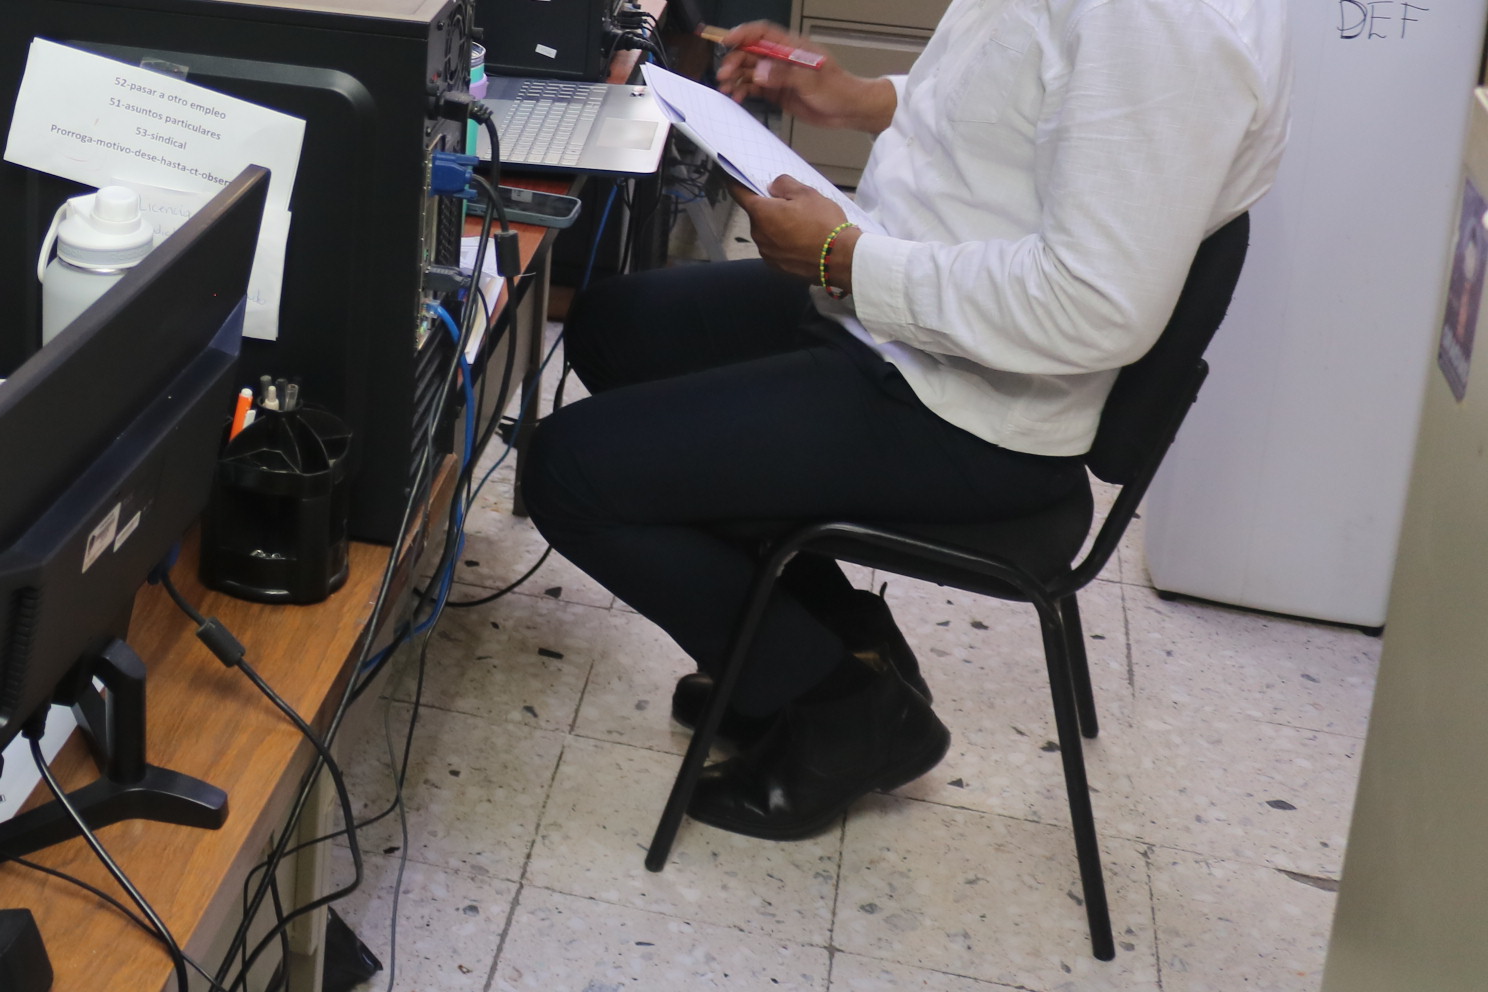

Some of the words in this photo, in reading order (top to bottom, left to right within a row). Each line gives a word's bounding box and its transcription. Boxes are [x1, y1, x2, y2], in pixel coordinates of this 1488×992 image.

[109, 97, 163, 121] 51-asuntos
[165, 114, 222, 142] particulares
[114, 77, 157, 100] 52-pasar
[159, 91, 166, 100] a
[167, 93, 189, 107] otro
[190, 99, 227, 121] empleo
[135, 126, 187, 151] 53-sindical
